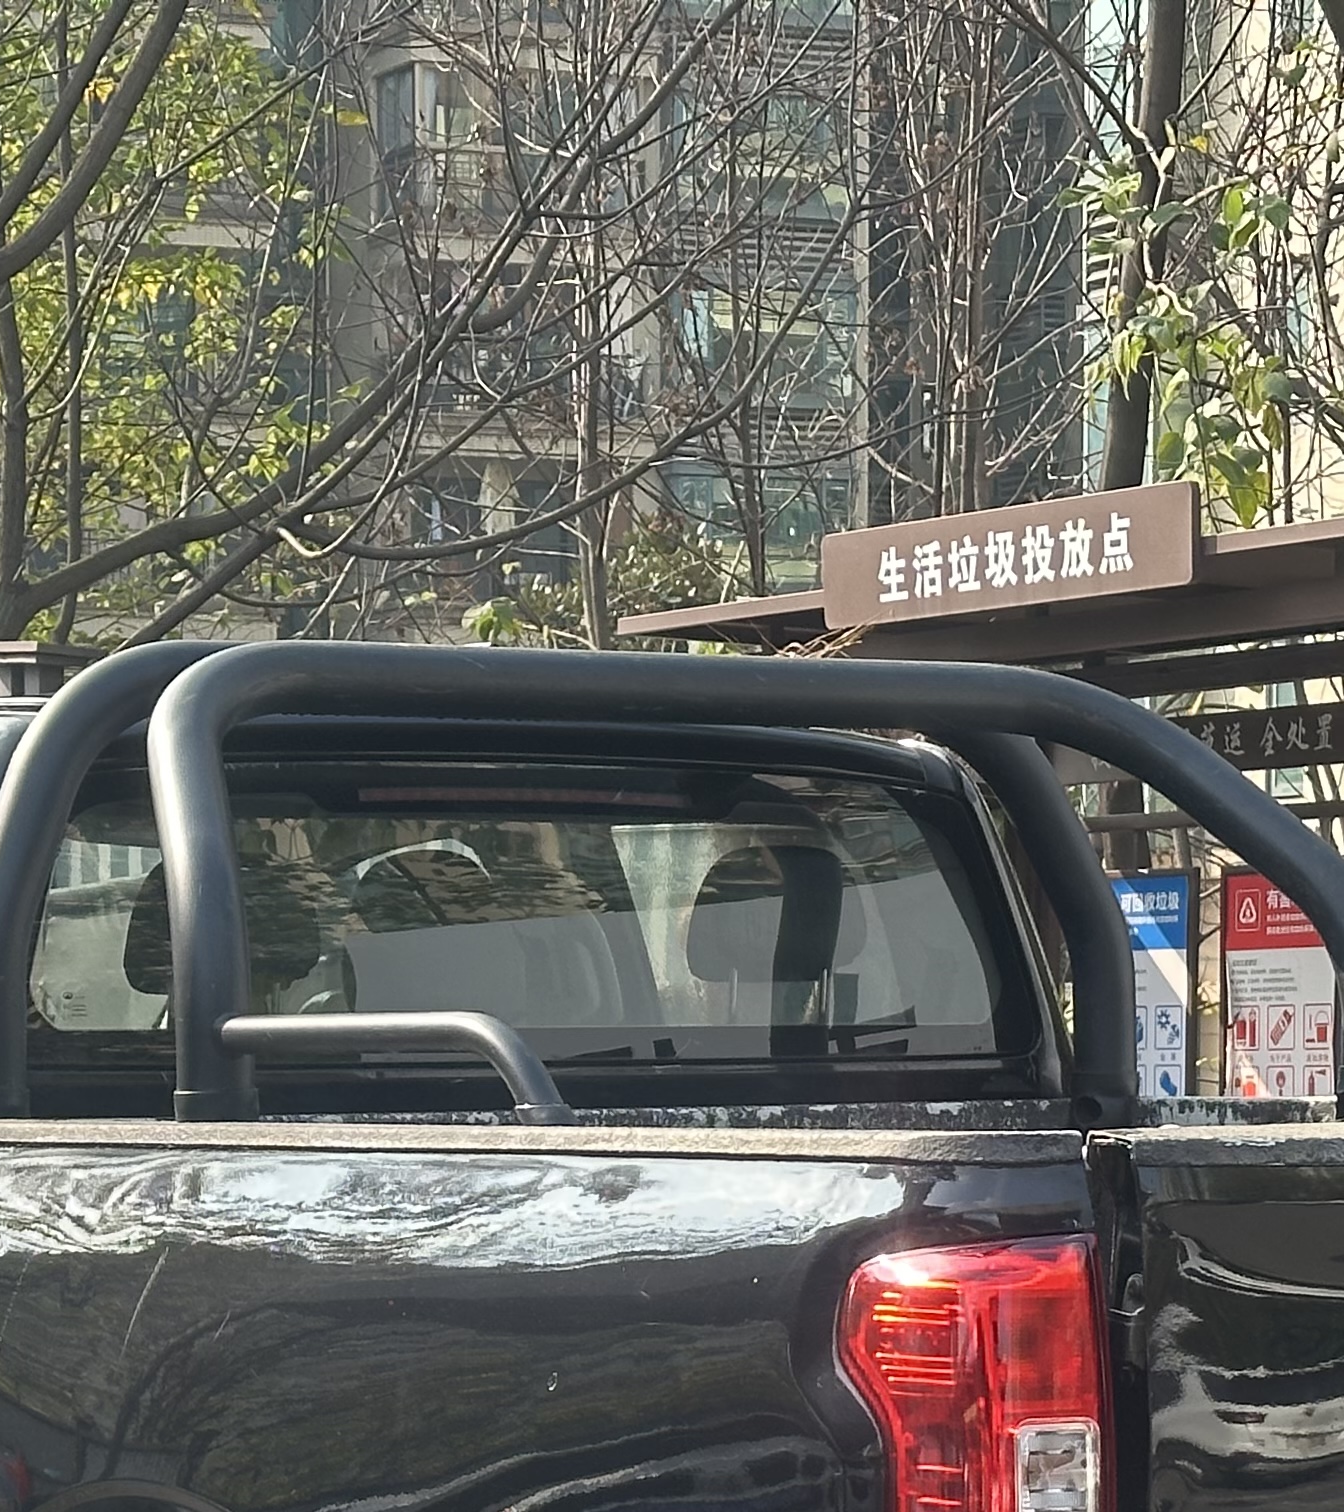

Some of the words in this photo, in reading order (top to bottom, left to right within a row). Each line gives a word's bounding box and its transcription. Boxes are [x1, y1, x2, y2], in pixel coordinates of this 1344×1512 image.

[877, 511, 1134, 603] 生活垃圾投放点
[1266, 888, 1298, 909] 有害
